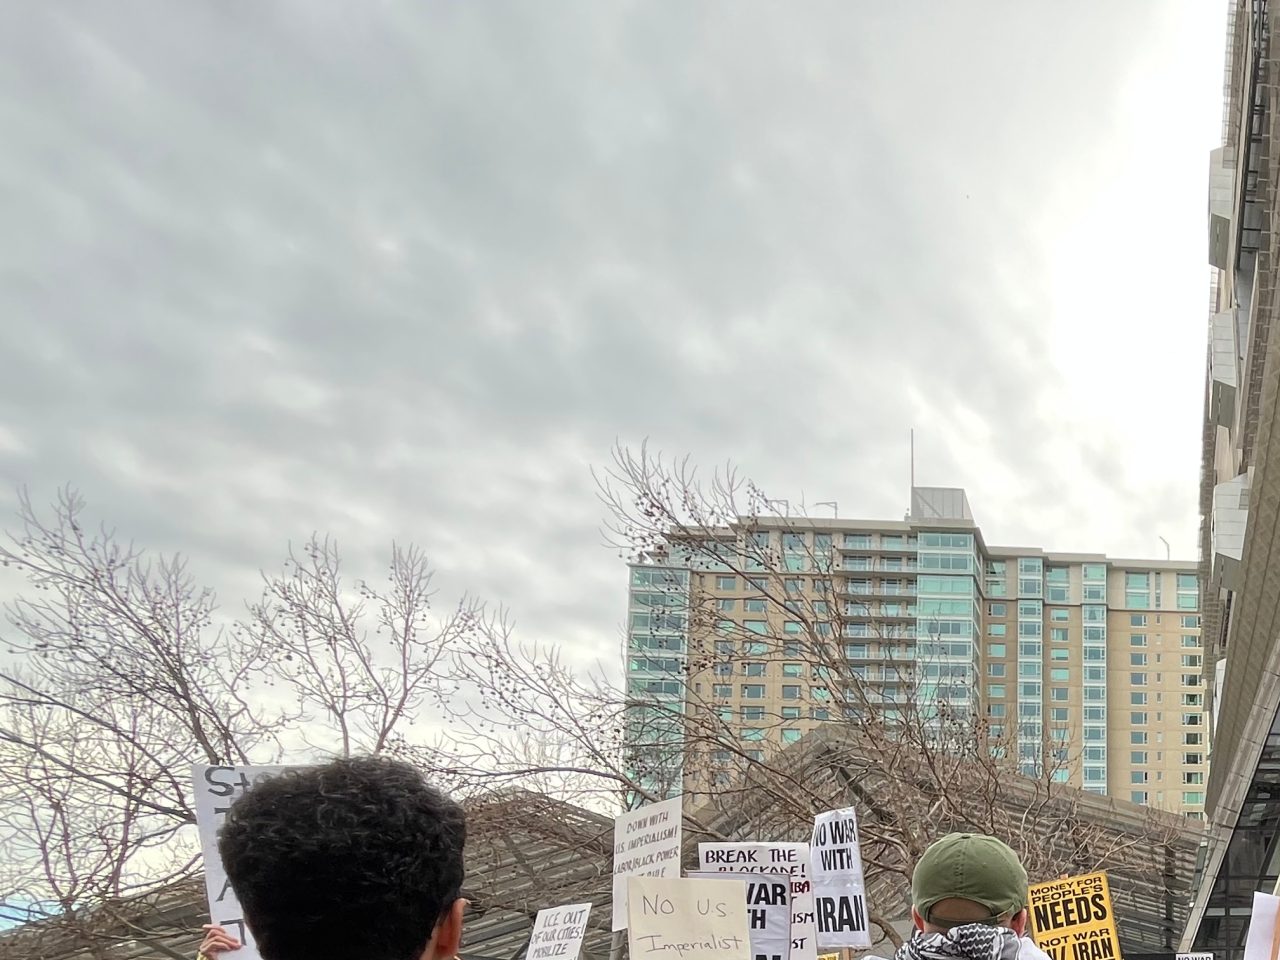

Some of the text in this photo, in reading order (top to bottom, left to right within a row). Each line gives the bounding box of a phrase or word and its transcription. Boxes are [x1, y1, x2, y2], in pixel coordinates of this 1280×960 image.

[626, 811, 669, 834] DOWN WITH
[829, 818, 857, 845] WAR
[705, 848, 798, 863] BREAK THE
[820, 848, 854, 871] WITH
[1031, 876, 1102, 896] MONEY FOR
[1032, 884, 1104, 905] PEOPLE'S
[642, 894, 734, 918] NO U.S.
[816, 894, 866, 933] IRAN
[1033, 893, 1107, 933] NEEDS
[542, 909, 586, 928] ICE OUT
[636, 934, 743, 958] Imperialist
[1039, 928, 1110, 949] NOT WAR
